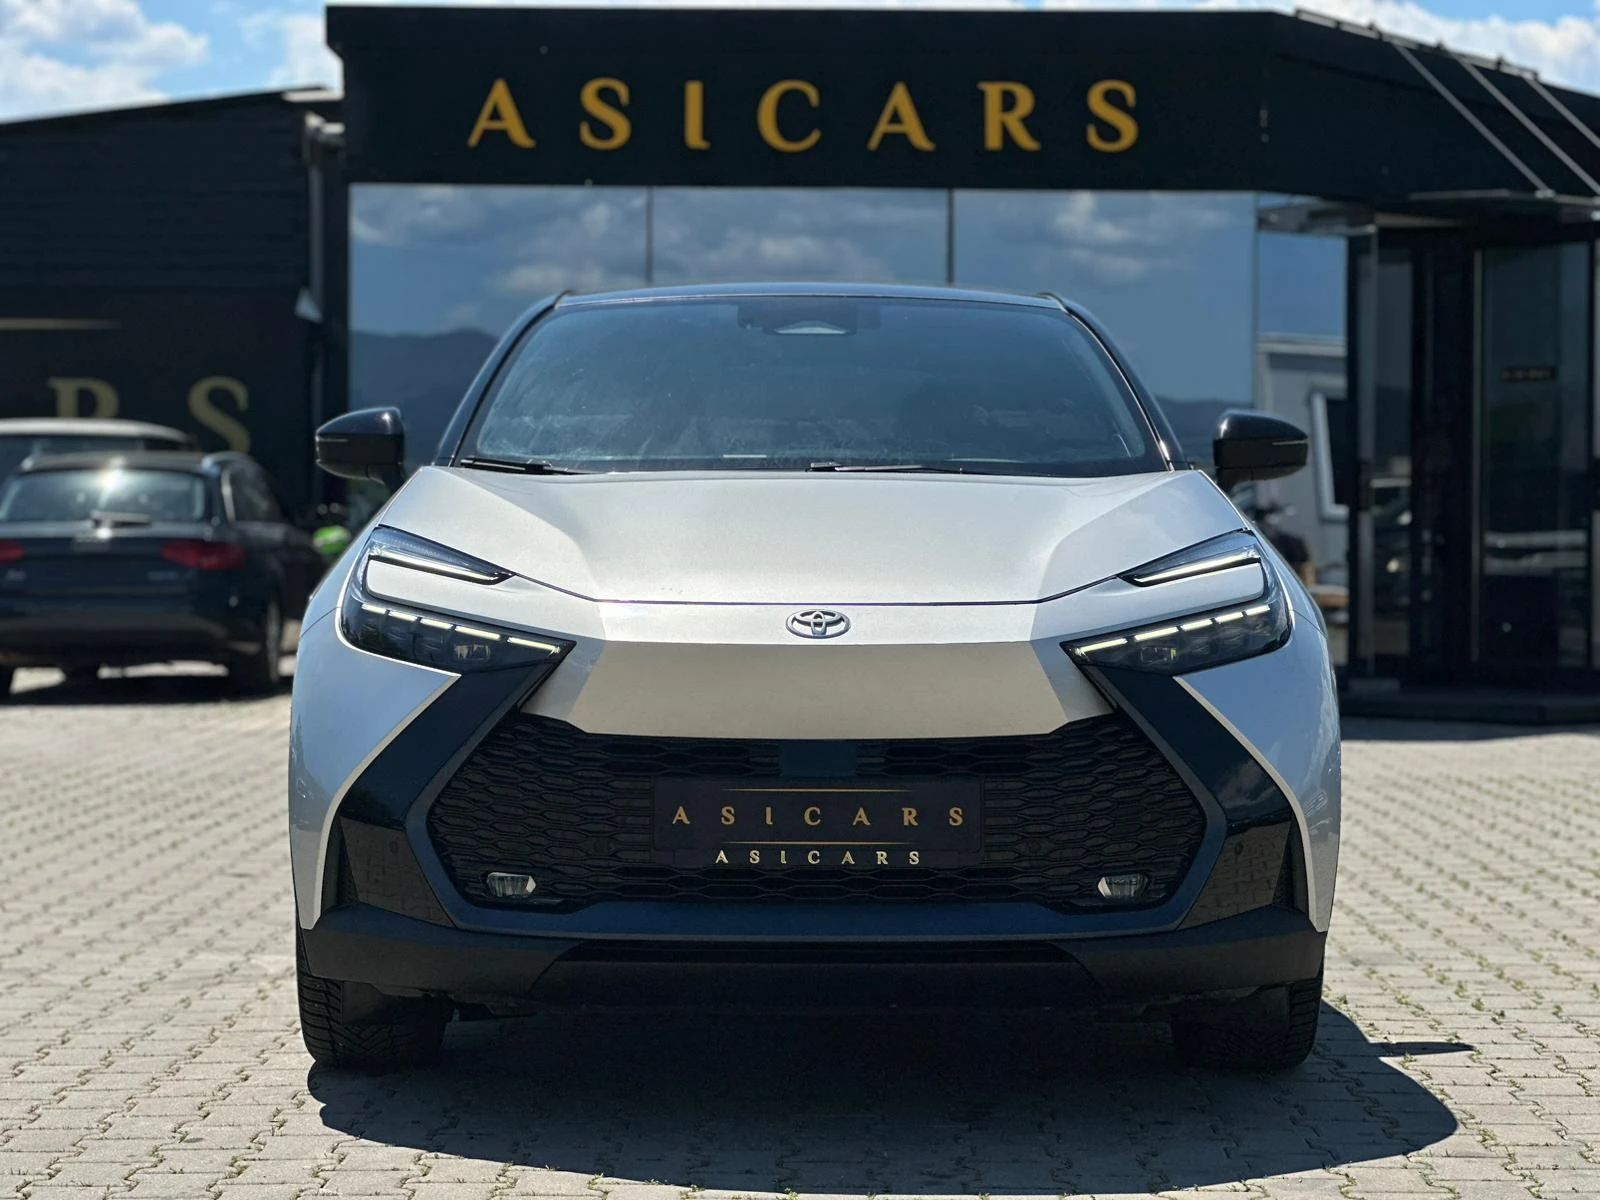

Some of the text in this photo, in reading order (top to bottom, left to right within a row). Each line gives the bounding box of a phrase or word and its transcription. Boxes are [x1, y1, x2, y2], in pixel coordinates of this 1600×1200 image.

[467, 78, 1138, 153] ASICARS
[671, 806, 964, 827] ASICARS
[714, 849, 921, 865] ASICARS
